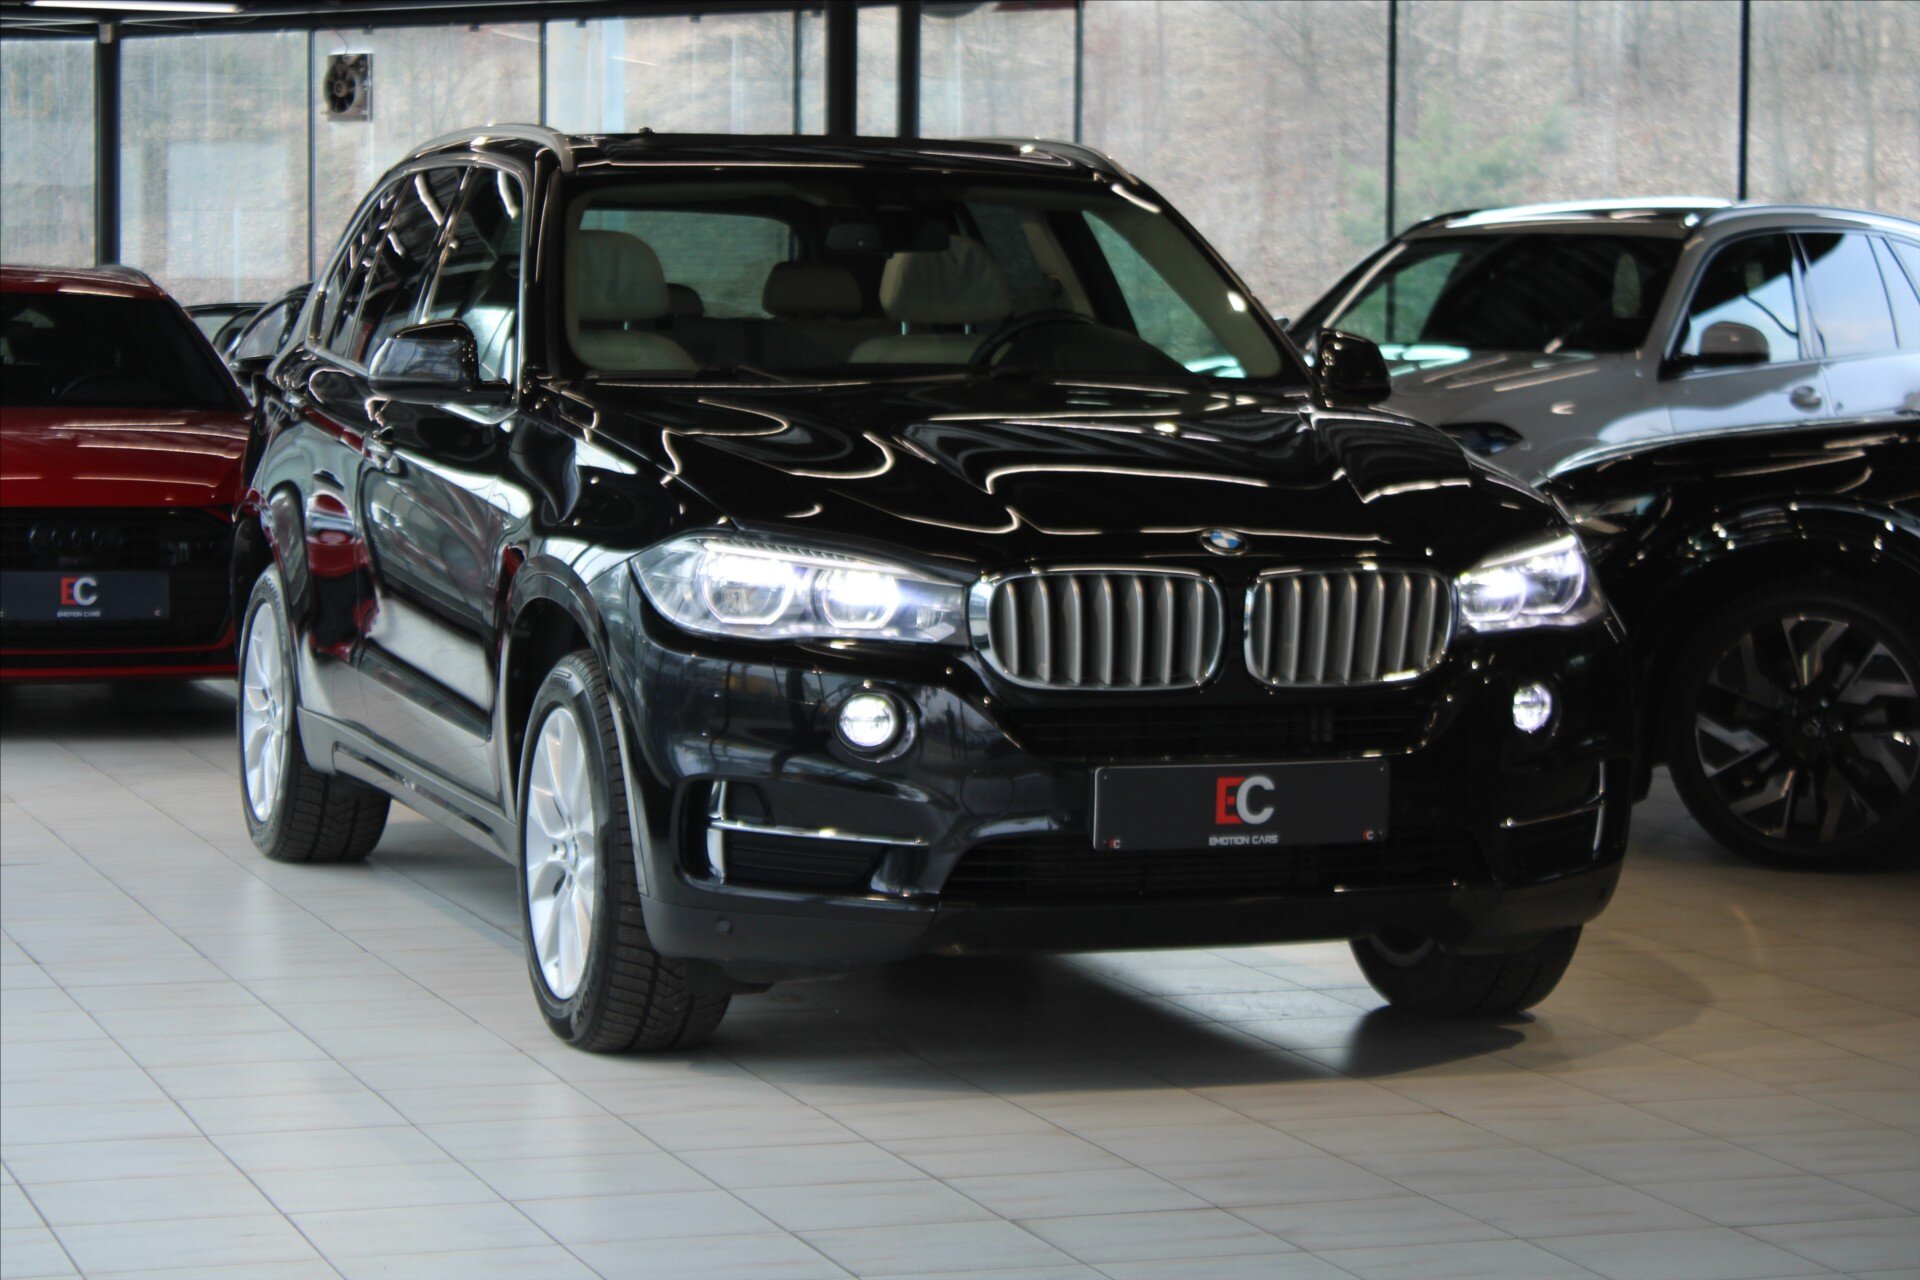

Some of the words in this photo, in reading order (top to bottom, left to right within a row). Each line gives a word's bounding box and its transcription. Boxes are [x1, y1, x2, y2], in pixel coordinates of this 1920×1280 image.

[60, 577, 98, 606] EC
[1216, 776, 1275, 824] EC
[1208, 836, 1250, 846] EMOTION
[1251, 835, 1279, 845] CARS
